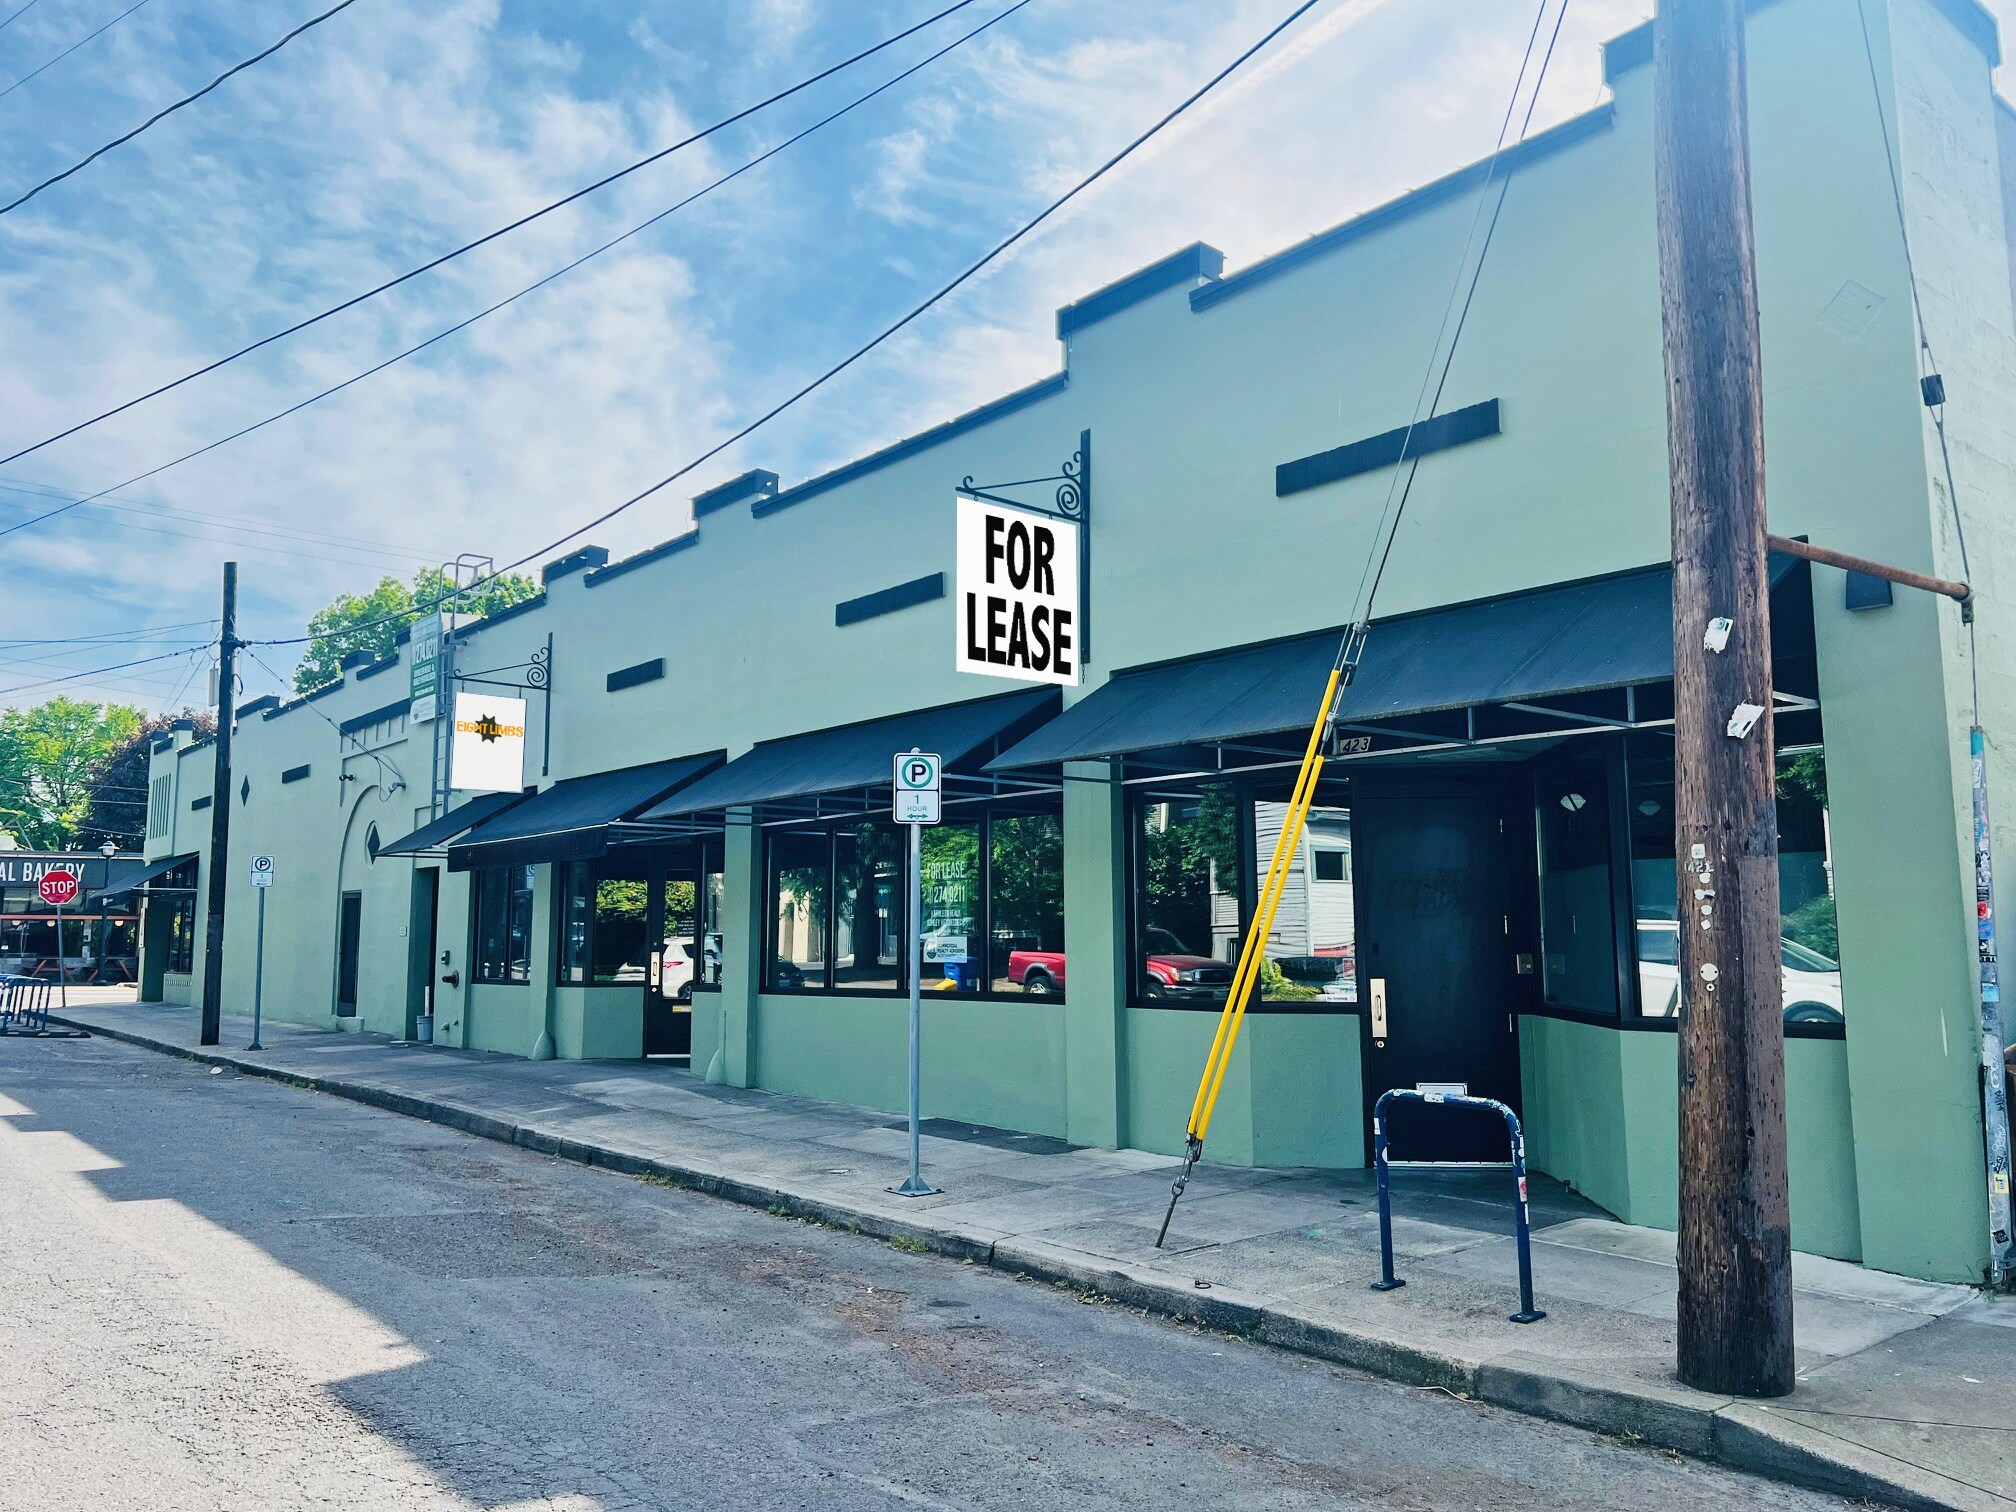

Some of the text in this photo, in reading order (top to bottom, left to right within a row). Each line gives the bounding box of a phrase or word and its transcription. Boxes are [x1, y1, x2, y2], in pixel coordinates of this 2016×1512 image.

[985, 514, 1055, 596] FOR
[966, 591, 1072, 676] LEASE
[456, 720, 524, 738] EIGHT LIMBS
[1342, 738, 1369, 752] 423
[911, 763, 927, 783] P
[914, 794, 920, 805] 1
[259, 860, 268, 869] P
[926, 861, 966, 880] FOR LEASE
[41, 880, 75, 895] STOP
